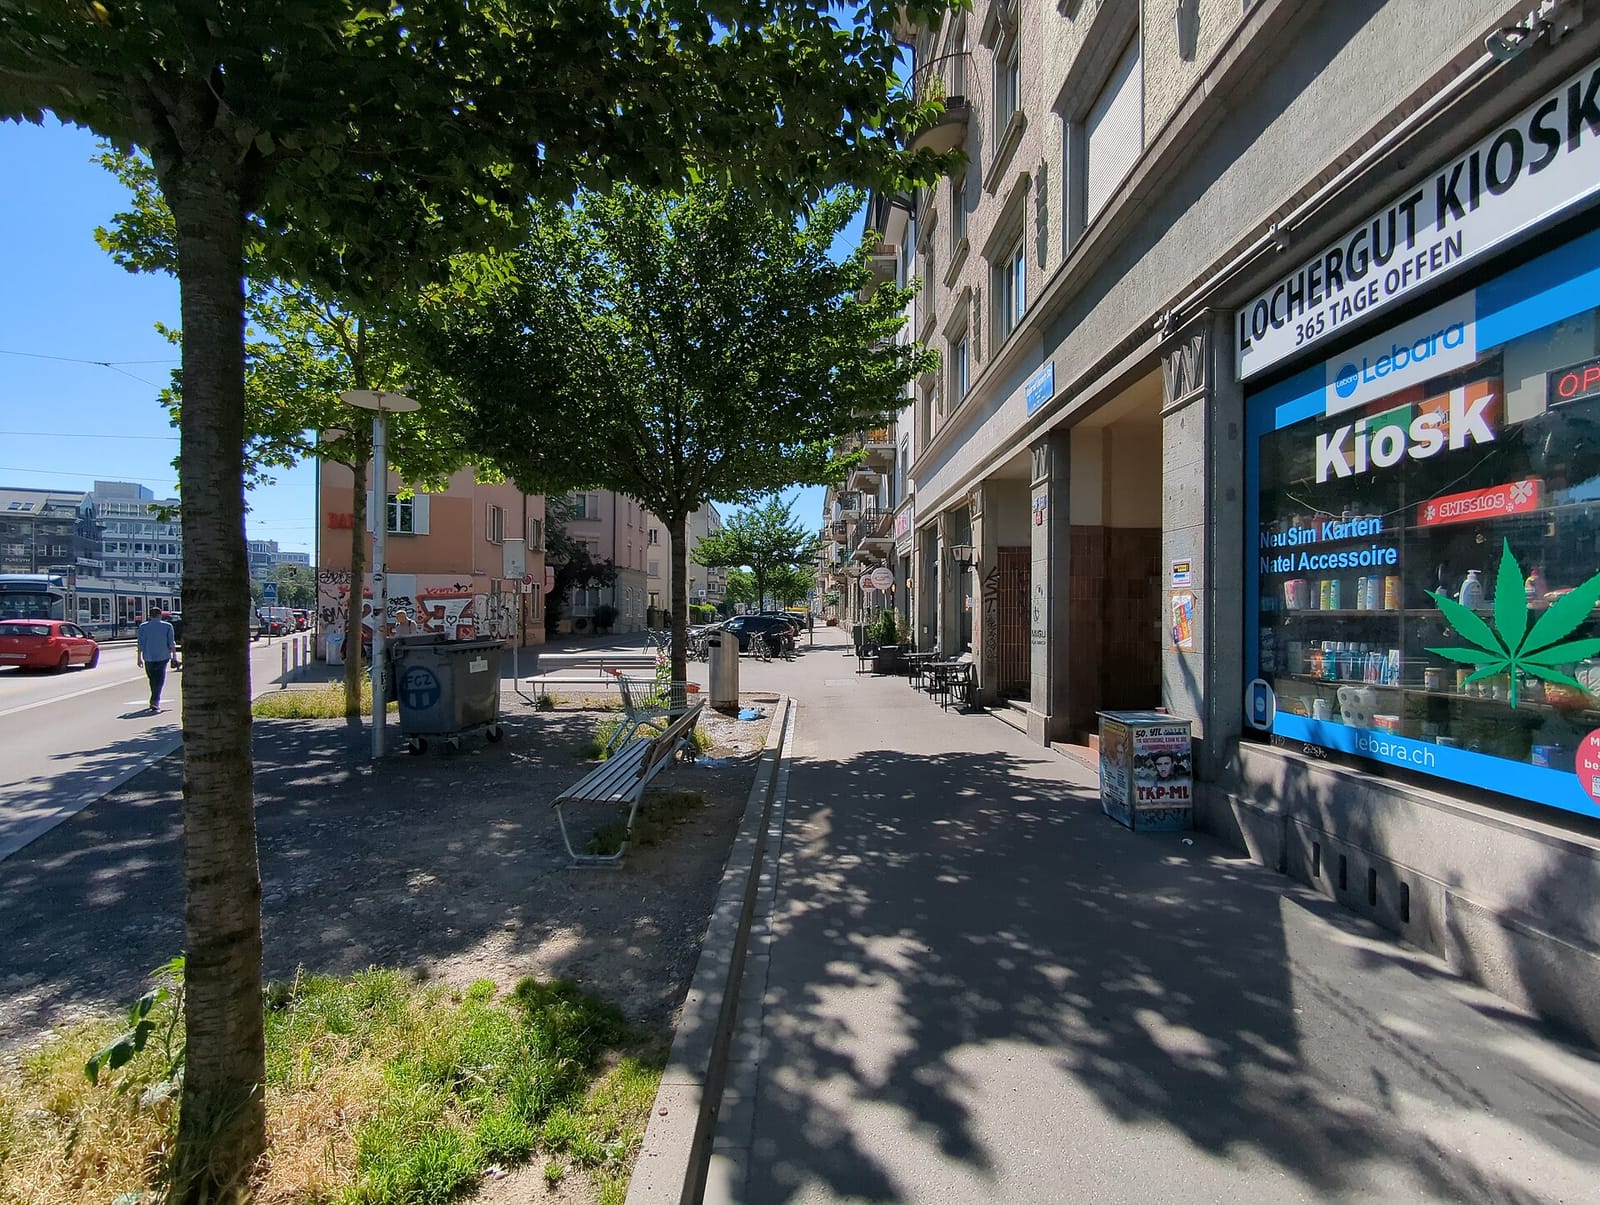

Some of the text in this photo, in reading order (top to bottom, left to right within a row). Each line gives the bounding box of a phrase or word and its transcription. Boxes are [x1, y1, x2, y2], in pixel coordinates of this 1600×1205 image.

[1240, 68, 1600, 351] LOCHERGUT KIOSK
[1295, 230, 1463, 346] 365 TAGE OFFEN
[1362, 322, 1465, 384] Lebara
[1558, 366, 1600, 397] OP
[1315, 385, 1496, 484] Kiosk
[1439, 493, 1505, 517] SWISSLOS
[1321, 517, 1381, 541] Karten
[1260, 545, 1397, 574] Natel Accessoire
[1355, 730, 1436, 767] lebara.ch
[1137, 785, 1189, 800] TKP-ML
